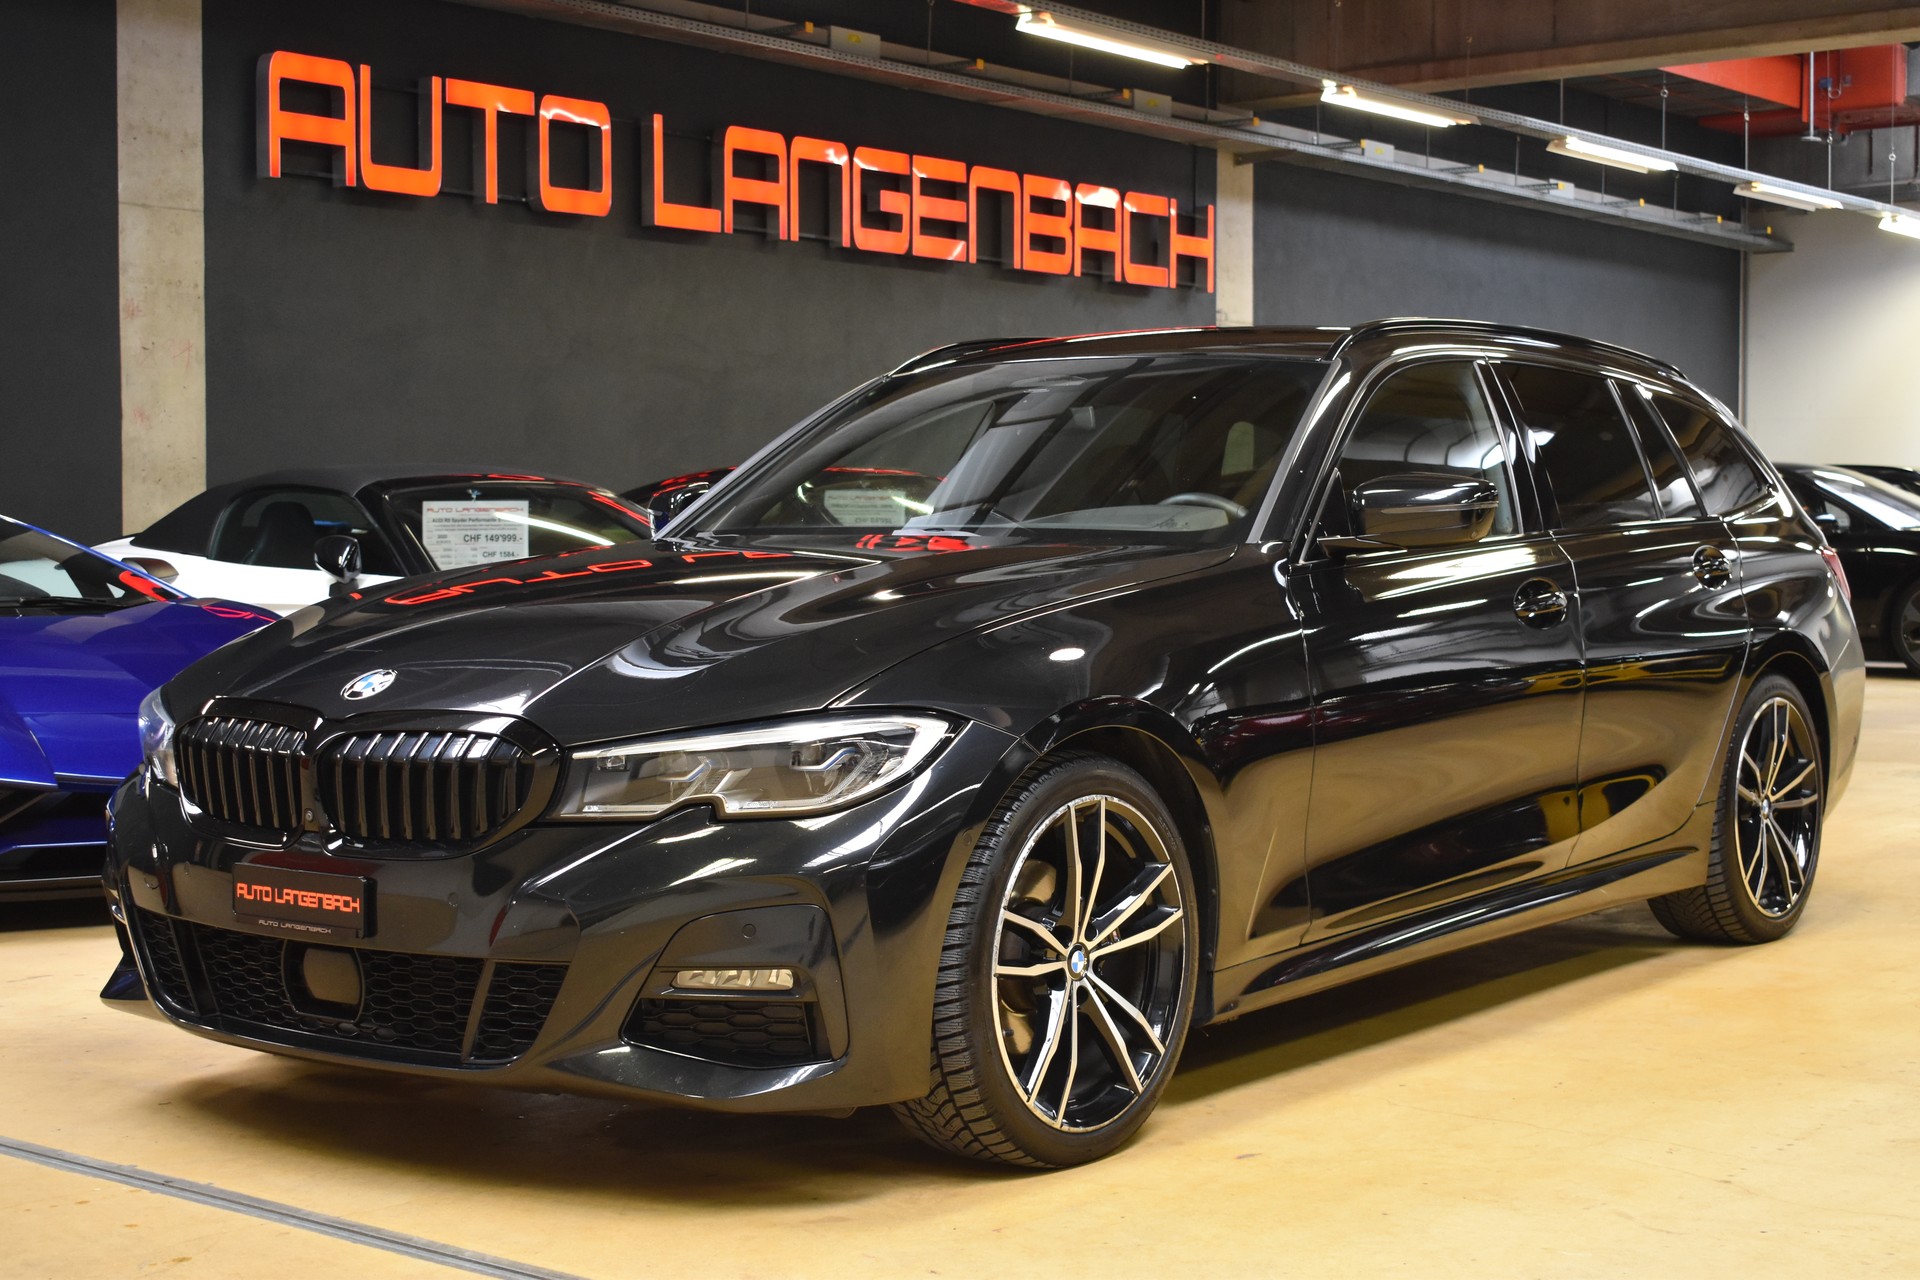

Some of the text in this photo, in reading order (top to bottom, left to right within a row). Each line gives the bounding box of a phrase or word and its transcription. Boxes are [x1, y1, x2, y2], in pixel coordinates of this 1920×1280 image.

[269, 51, 1214, 292] AUTO LANGENBACH
[463, 534, 523, 543] CHF 149'999.-
[236, 882, 360, 914] AUTO LANGENBACH
[258, 919, 332, 934] AUTO LANGENBACH
